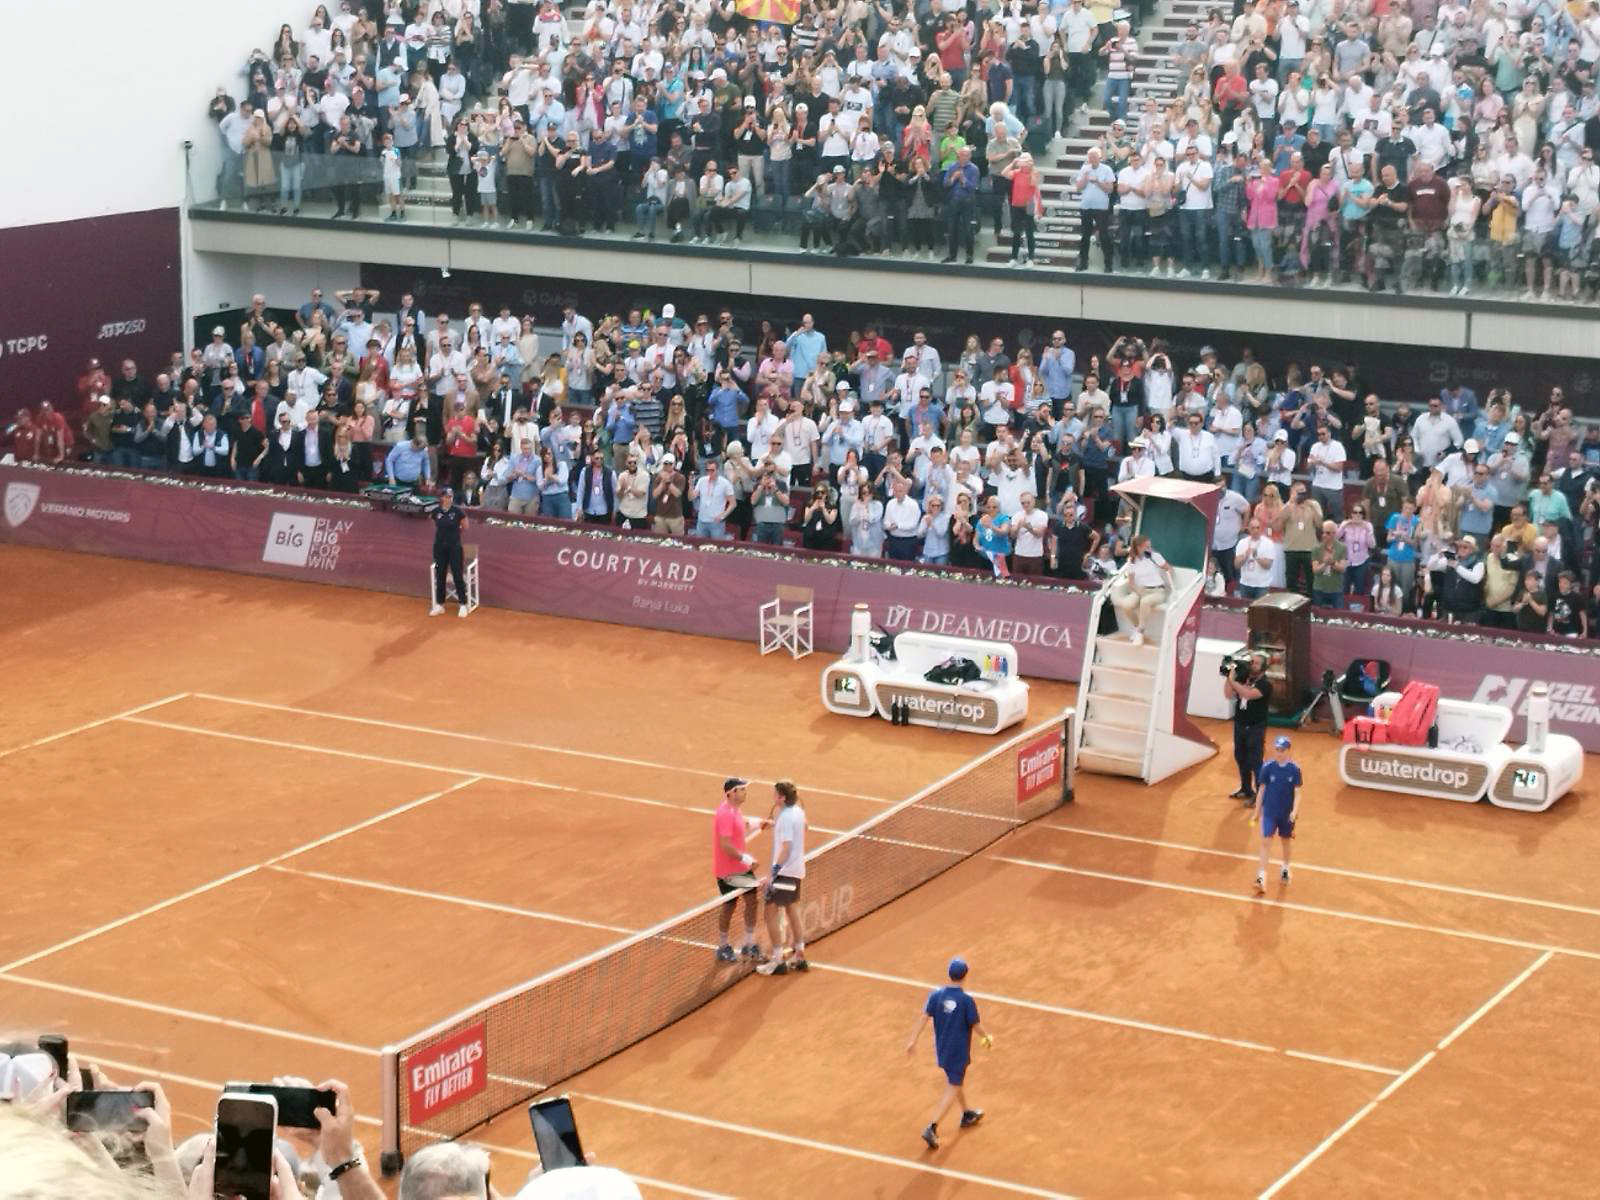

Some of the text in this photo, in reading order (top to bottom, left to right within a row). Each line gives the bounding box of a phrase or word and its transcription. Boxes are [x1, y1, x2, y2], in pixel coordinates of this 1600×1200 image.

[7, 334, 48, 355] TCPC
[275, 524, 304, 547] BIG
[313, 530, 338, 545] BIG
[316, 517, 354, 534] PLAY
[308, 556, 338, 570] WIN
[310, 543, 341, 559] FOR
[557, 548, 698, 582] COURTYARD
[921, 609, 1073, 649] DEAMEDICA
[1361, 757, 1469, 788] waterdrop
[800, 884, 855, 932] OUR
[412, 1041, 482, 1092] Emirates
[424, 1066, 473, 1110] FLY BETTER
